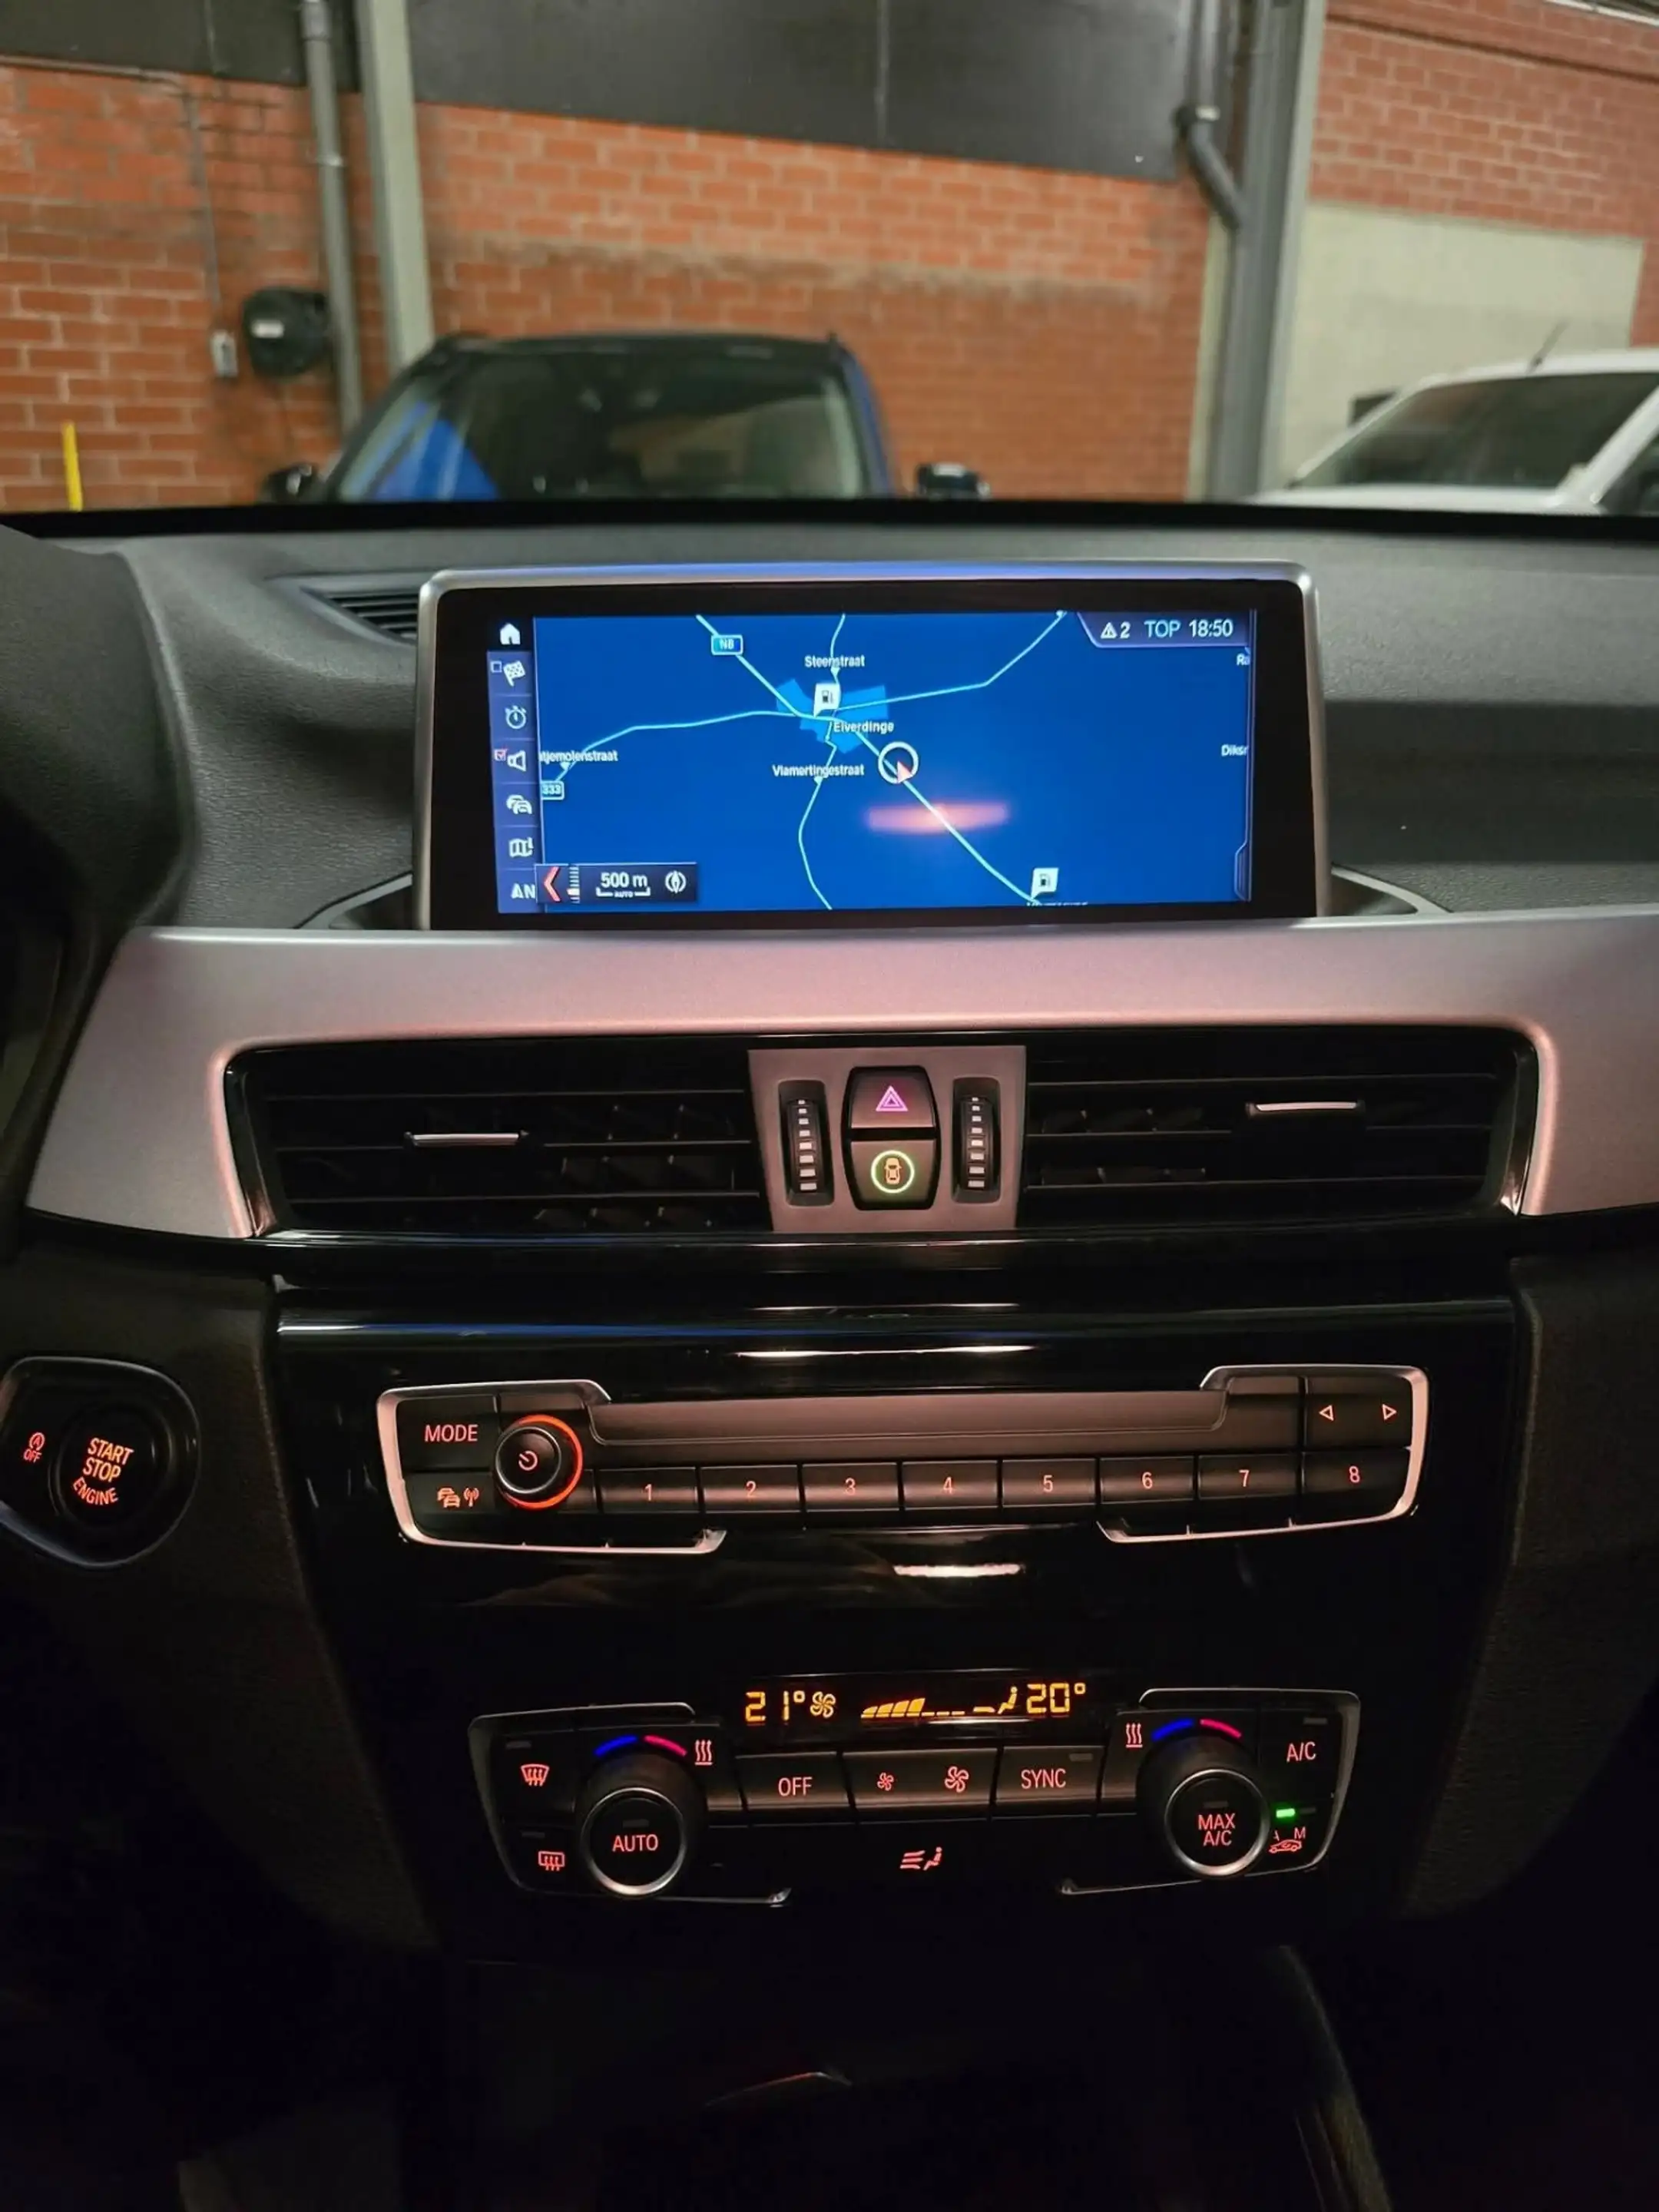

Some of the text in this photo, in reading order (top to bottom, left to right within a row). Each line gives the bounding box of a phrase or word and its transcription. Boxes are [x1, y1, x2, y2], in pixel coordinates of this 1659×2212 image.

[1120, 619, 1233, 639] 2 TOP 18:50
[804, 655, 865, 667] Steenstraat
[772, 763, 865, 778] Vlamertingestraat
[601, 872, 647, 889] 500 m
[424, 1424, 478, 1442] MODE
[23, 1449, 42, 1463] OFF
[88, 1437, 134, 1465] START
[82, 1457, 121, 1483] STOP
[1239, 1469, 1250, 1487] 7
[1348, 1465, 1360, 1483] 8
[746, 1480, 757, 1498] 2
[844, 1477, 856, 1496] 3
[943, 1476, 953, 1494] 4
[1043, 1474, 1053, 1492] 5
[1141, 1471, 1153, 1489] 6
[72, 1476, 118, 1505] ENGINE
[644, 1483, 653, 1501] 1
[1286, 1741, 1316, 1762] A/C
[778, 1777, 813, 1796] OFF
[1021, 1768, 1066, 1789] SYNC
[1198, 1813, 1235, 1831] MAX
[1203, 1830, 1232, 1846] A/C
[1294, 1826, 1306, 1839] M
[612, 1833, 658, 1852] AUTO
